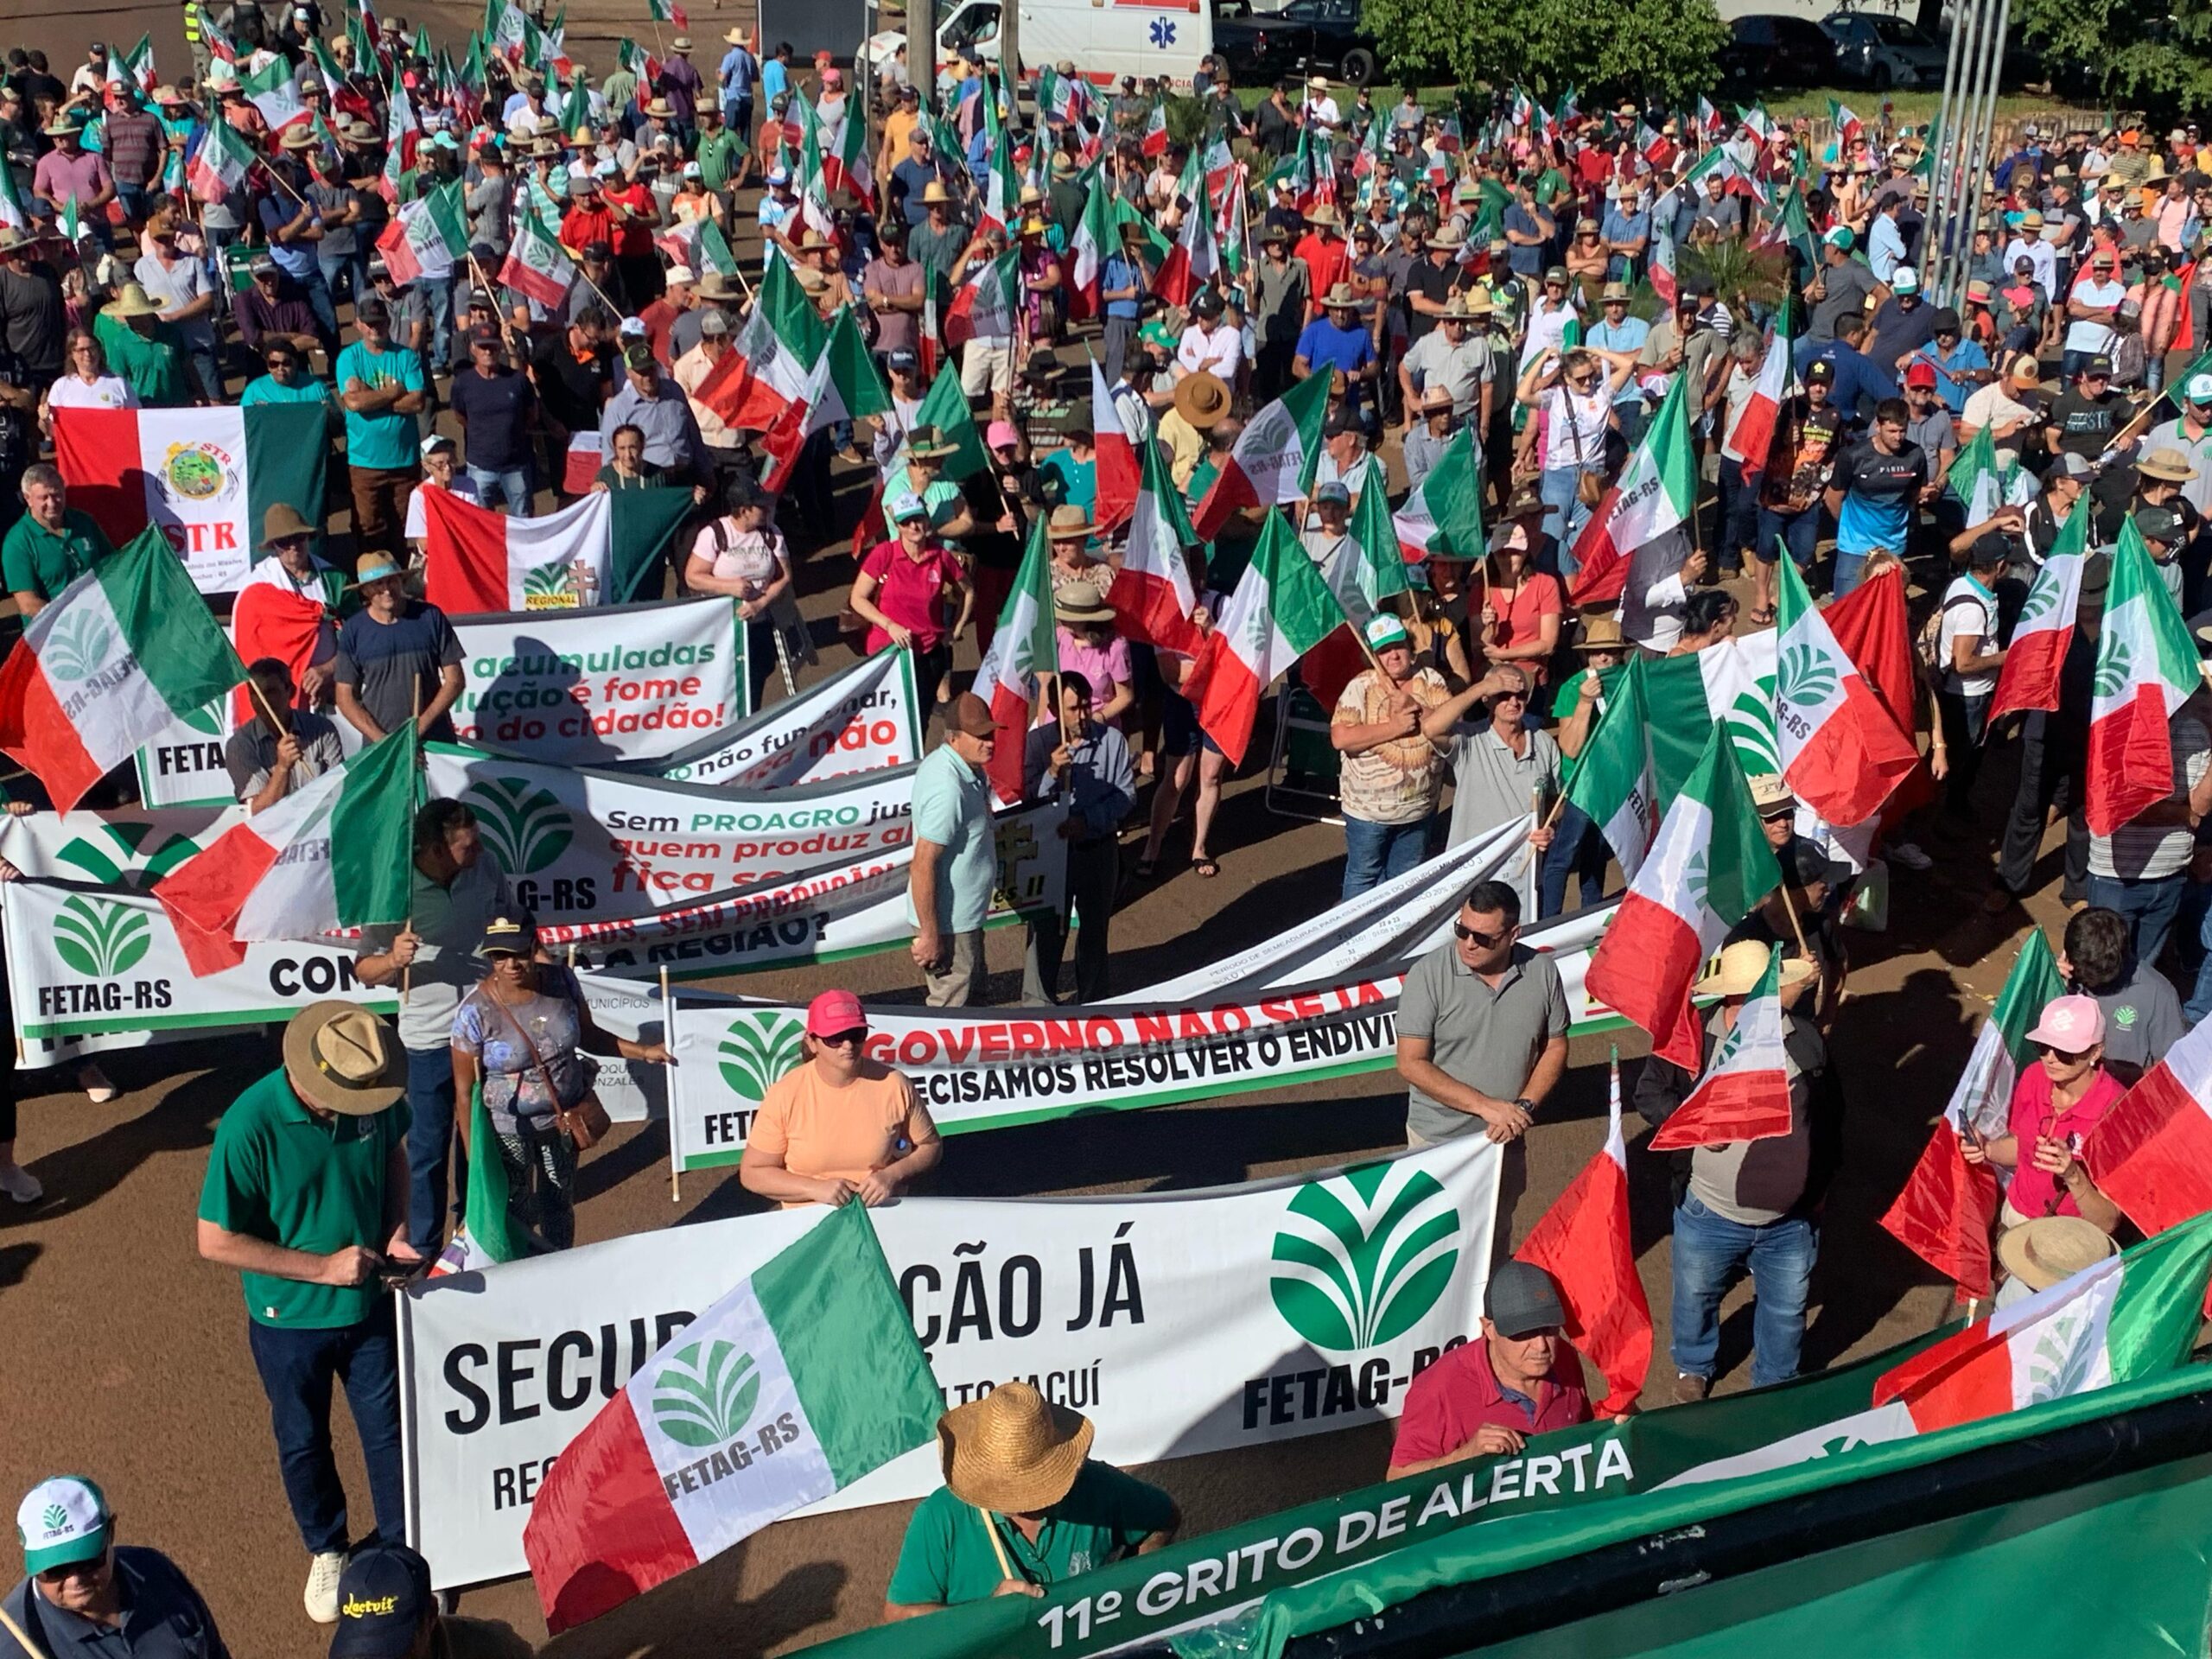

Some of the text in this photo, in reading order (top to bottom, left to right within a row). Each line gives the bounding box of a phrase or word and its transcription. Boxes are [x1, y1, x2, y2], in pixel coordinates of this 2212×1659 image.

[200, 442, 232, 467] STR
[1879, 465, 1905, 474] PARIS
[1605, 476, 1659, 524] ETAG-RS
[162, 521, 238, 553] STR
[526, 595, 576, 606] REGIONAL
[473, 641, 715, 678] acumuladas
[453, 676, 702, 719] lução é fome
[496, 715, 546, 741] do
[558, 702, 725, 738] cidadão!
[808, 715, 897, 758] não
[157, 741, 226, 776] FETA
[698, 748, 753, 776] não
[607, 800, 912, 832] Sem PROAGRO jus
[609, 838, 721, 860] quem
[733, 832, 871, 863] produz
[517, 876, 597, 912] G-RS
[612, 860, 715, 893] fica
[39, 955, 375, 1016] FETAG-RS COM
[864, 1014, 1124, 1065] GOVERNO
[600, 1064, 633, 1075] OQUE
[704, 1012, 1398, 1145] FET ECISAMOS RESOLVER O ENDIVI
[1067, 1220, 1146, 1333] JÁ
[662, 1410, 801, 1503] FETAG-RS
[1038, 1439, 1634, 1649] 11º GRITO DE ALERTA
